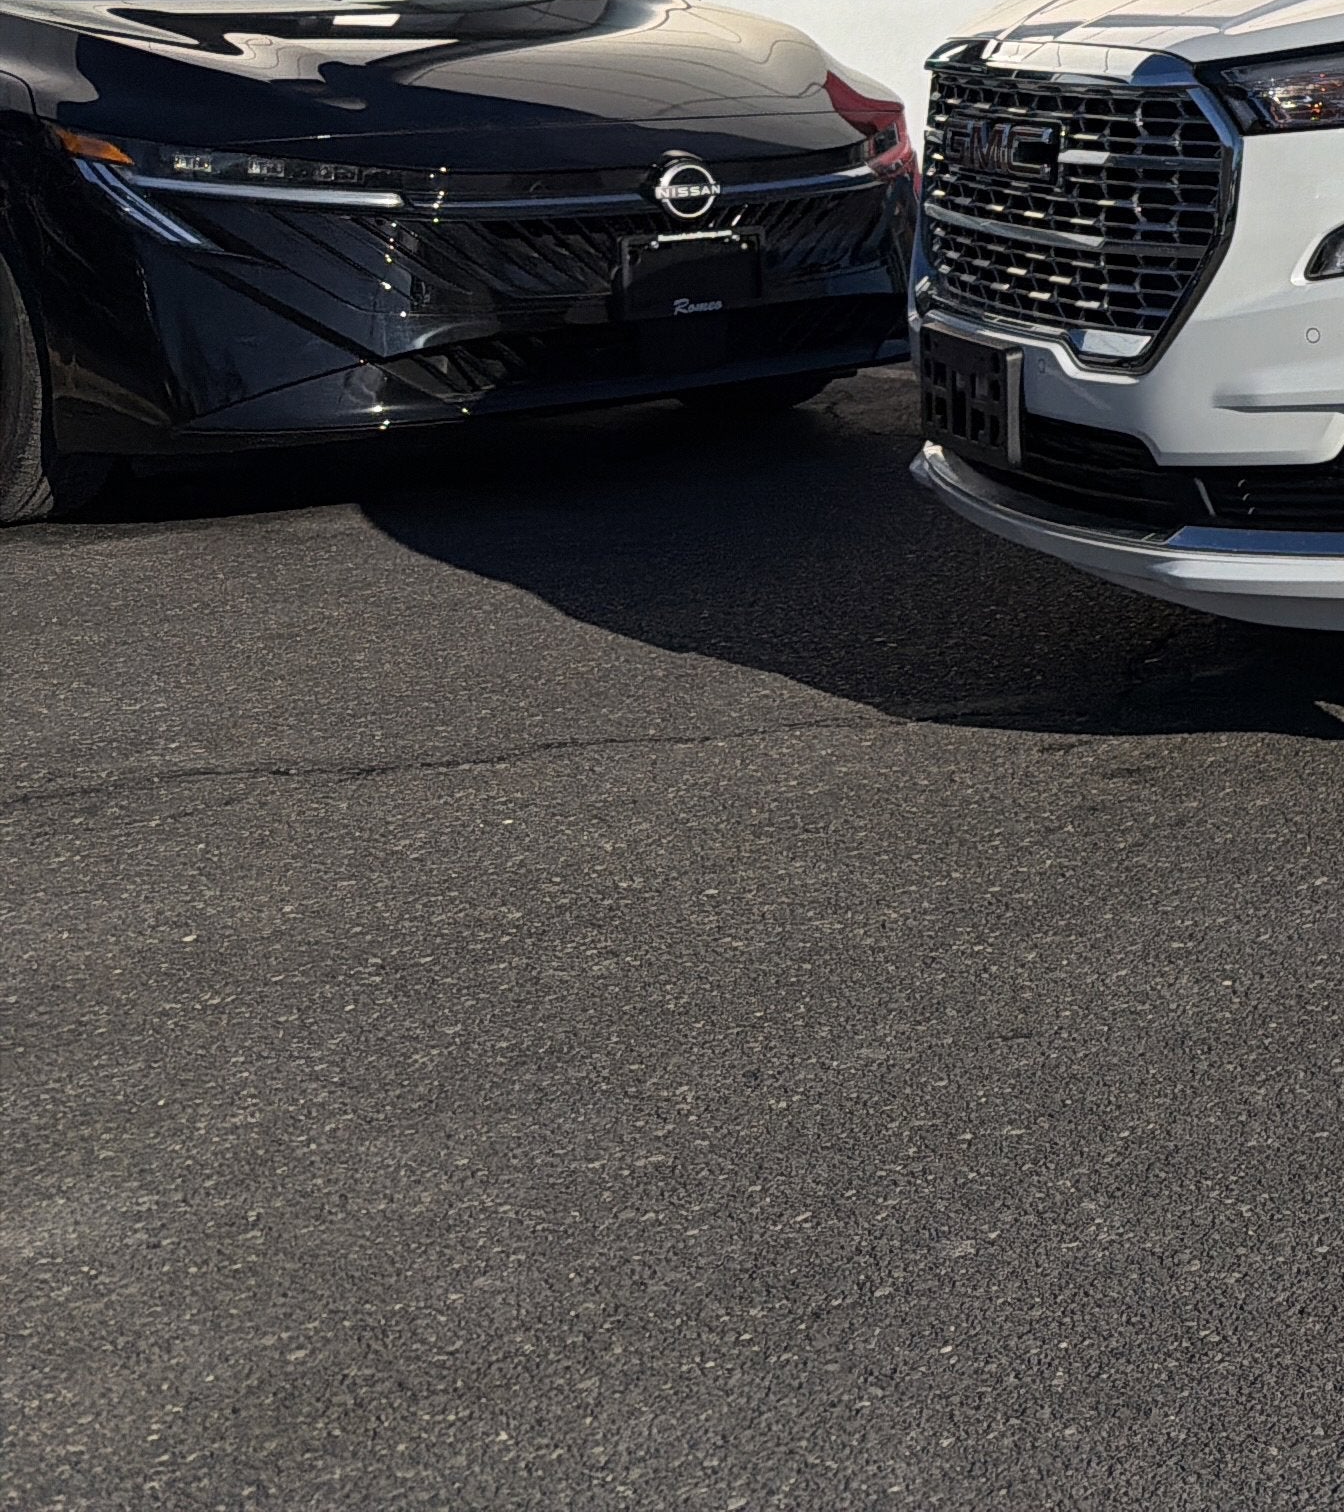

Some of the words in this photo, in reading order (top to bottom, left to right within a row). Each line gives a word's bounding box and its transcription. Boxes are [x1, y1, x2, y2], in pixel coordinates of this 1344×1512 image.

[944, 114, 1055, 182] GMC
[658, 184, 721, 199] NISSAN
[673, 298, 722, 316] Romeo
